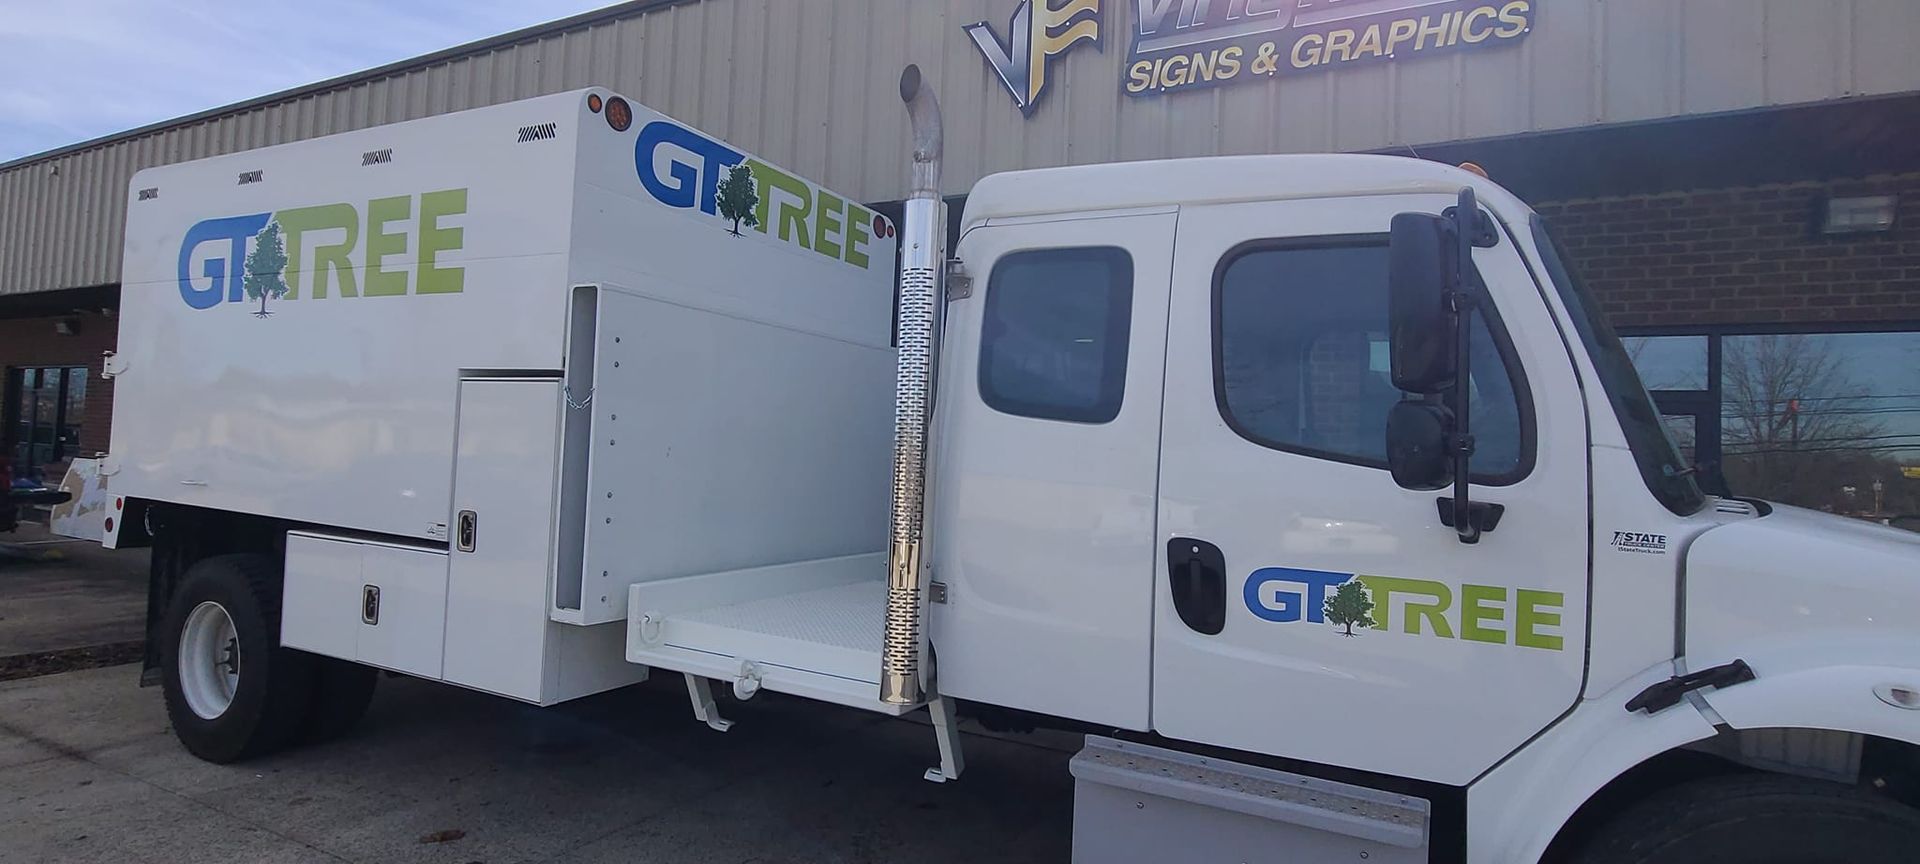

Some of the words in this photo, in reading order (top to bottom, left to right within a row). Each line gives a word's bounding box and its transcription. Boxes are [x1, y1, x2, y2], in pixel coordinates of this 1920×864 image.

[1126, 47, 1243, 93] SIGNS
[1251, 41, 1279, 74] &
[1290, 1, 1530, 68] GRAPHICS
[635, 121, 746, 216] GT
[744, 159, 871, 269] TREE
[178, 212, 272, 310] GT
[273, 188, 468, 300] TREE
[1243, 567, 1355, 624] GT
[1355, 575, 1564, 651] TREE
